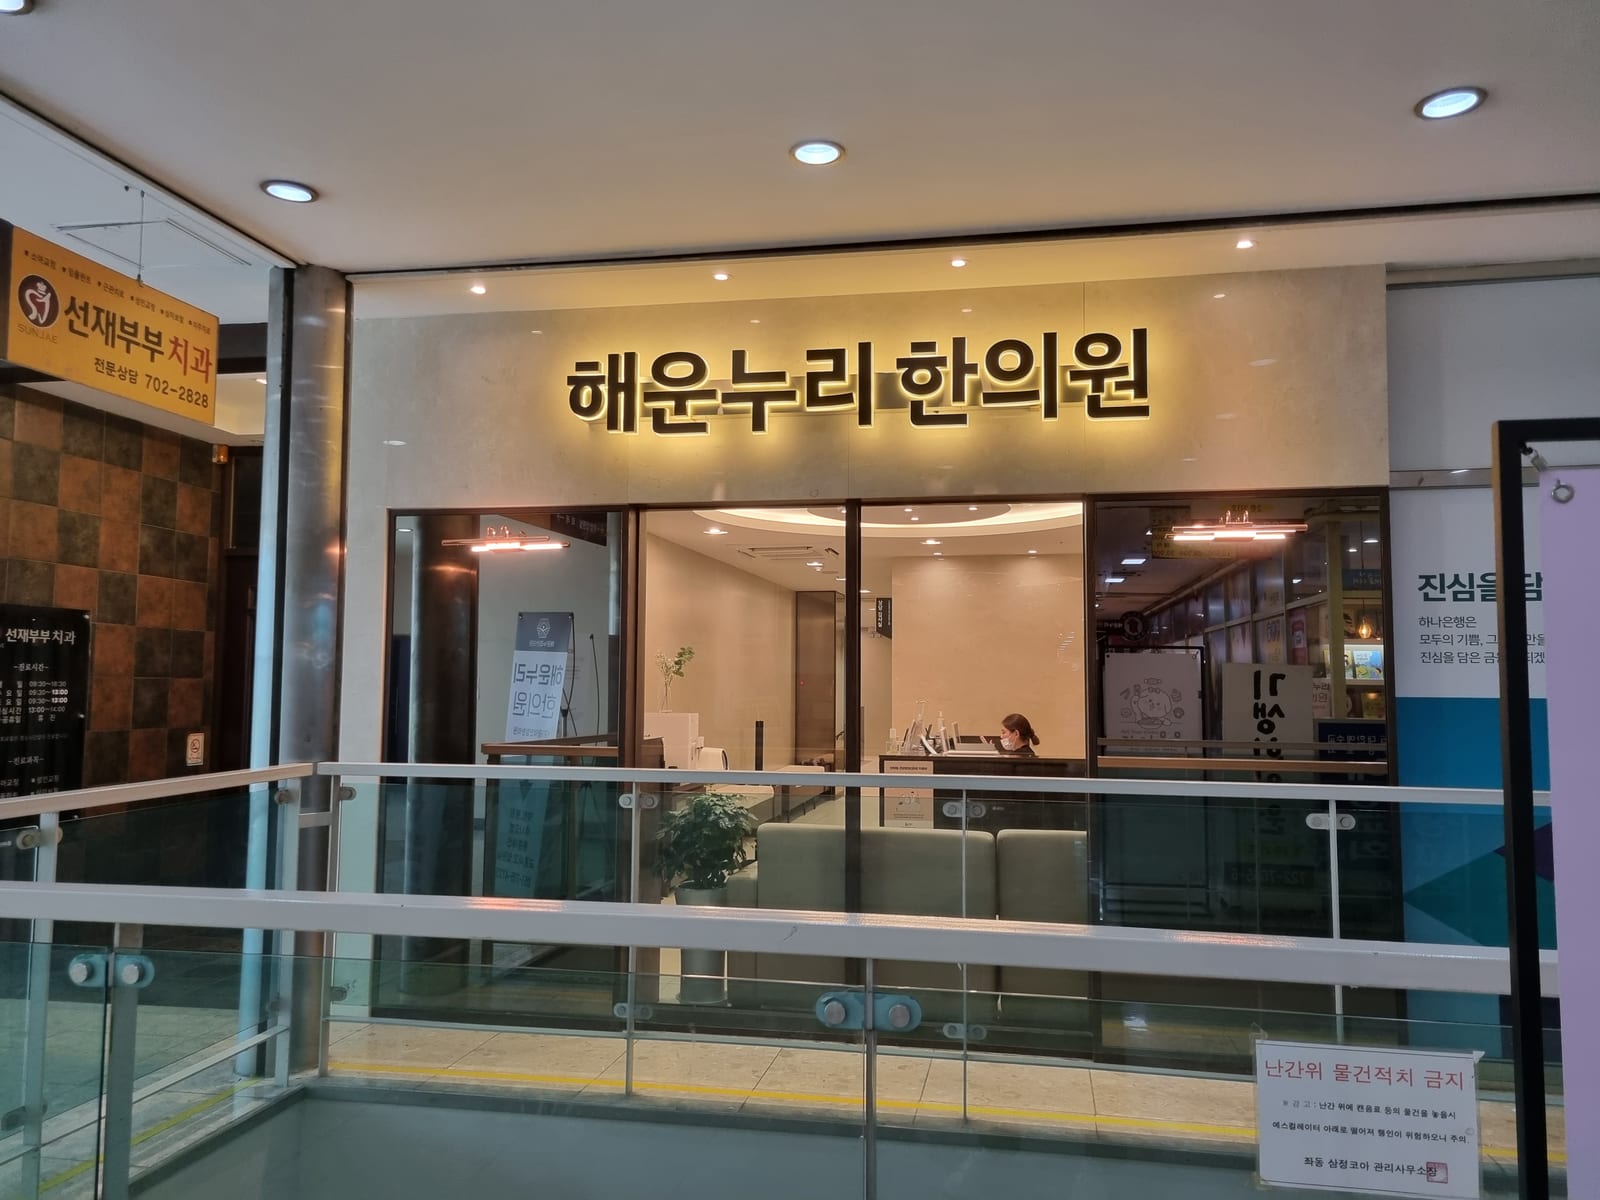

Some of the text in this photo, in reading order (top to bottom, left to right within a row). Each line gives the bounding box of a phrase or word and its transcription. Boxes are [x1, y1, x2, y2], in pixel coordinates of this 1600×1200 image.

[94, 357, 209, 408] 전문상담 702-2828
[1418, 616, 1477, 628] 하나은행은
[1419, 634, 1454, 646] 모두의
[1420, 652, 1455, 664] 진심을
[1457, 652, 1481, 664] 담은
[1265, 1059, 1463, 1090] 난간위 물건적치 금지
[1319, 1101, 1335, 1110] 난간
[1338, 1103, 1354, 1112] 위에
[1384, 1106, 1400, 1115] 등의
[1404, 1108, 1428, 1118] 물건을
[1272, 1121, 1320, 1132] 에스컬레이터
[1323, 1125, 1348, 1134] 아래로
[1406, 1131, 1447, 1142] 위험하오니
[1328, 1158, 1369, 1171] 삼정코아
[1373, 1162, 1438, 1177] 관리사무소장
